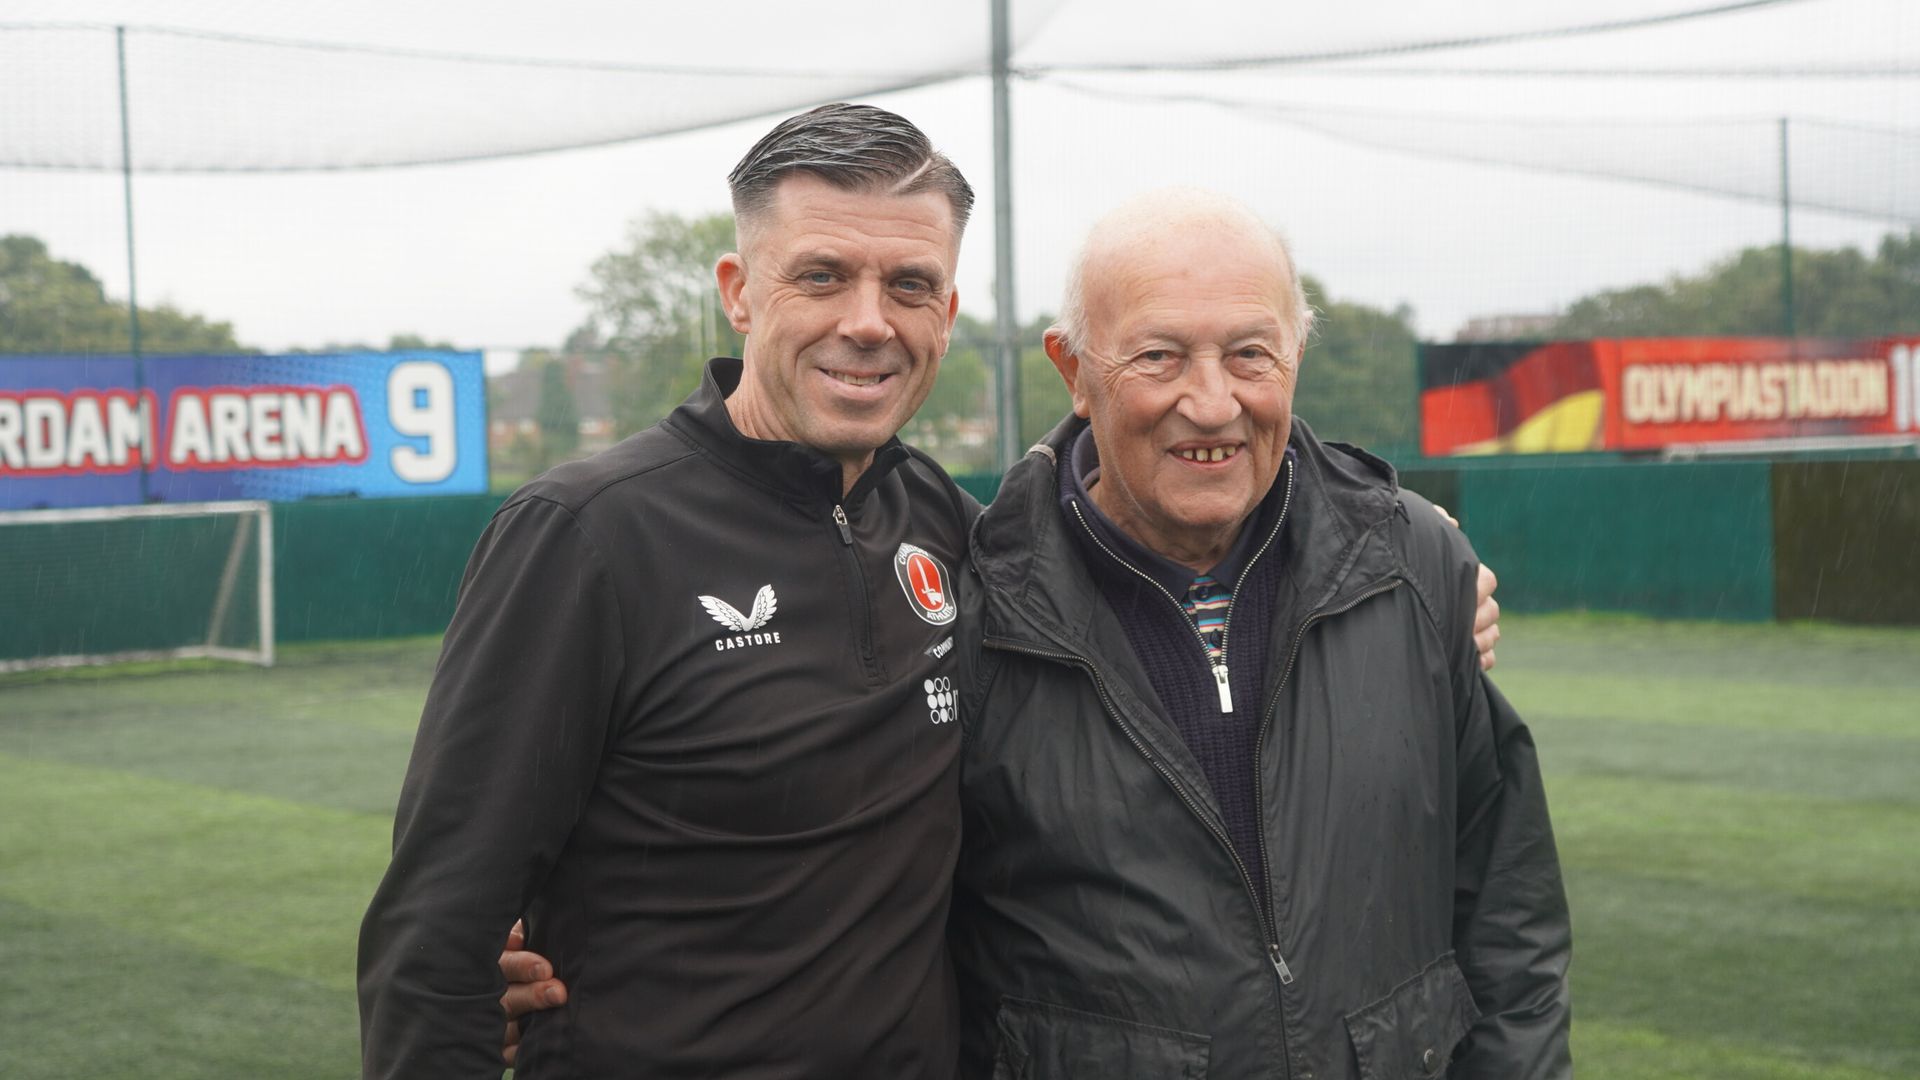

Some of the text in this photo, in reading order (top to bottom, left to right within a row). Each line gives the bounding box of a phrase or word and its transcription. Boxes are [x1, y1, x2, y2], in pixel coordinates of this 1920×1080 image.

[169, 391, 363, 464] ARENA
[387, 360, 456, 484] 9
[1622, 360, 1888, 424] OLYMPIASTADION
[715, 632, 781, 651] CASTORE
